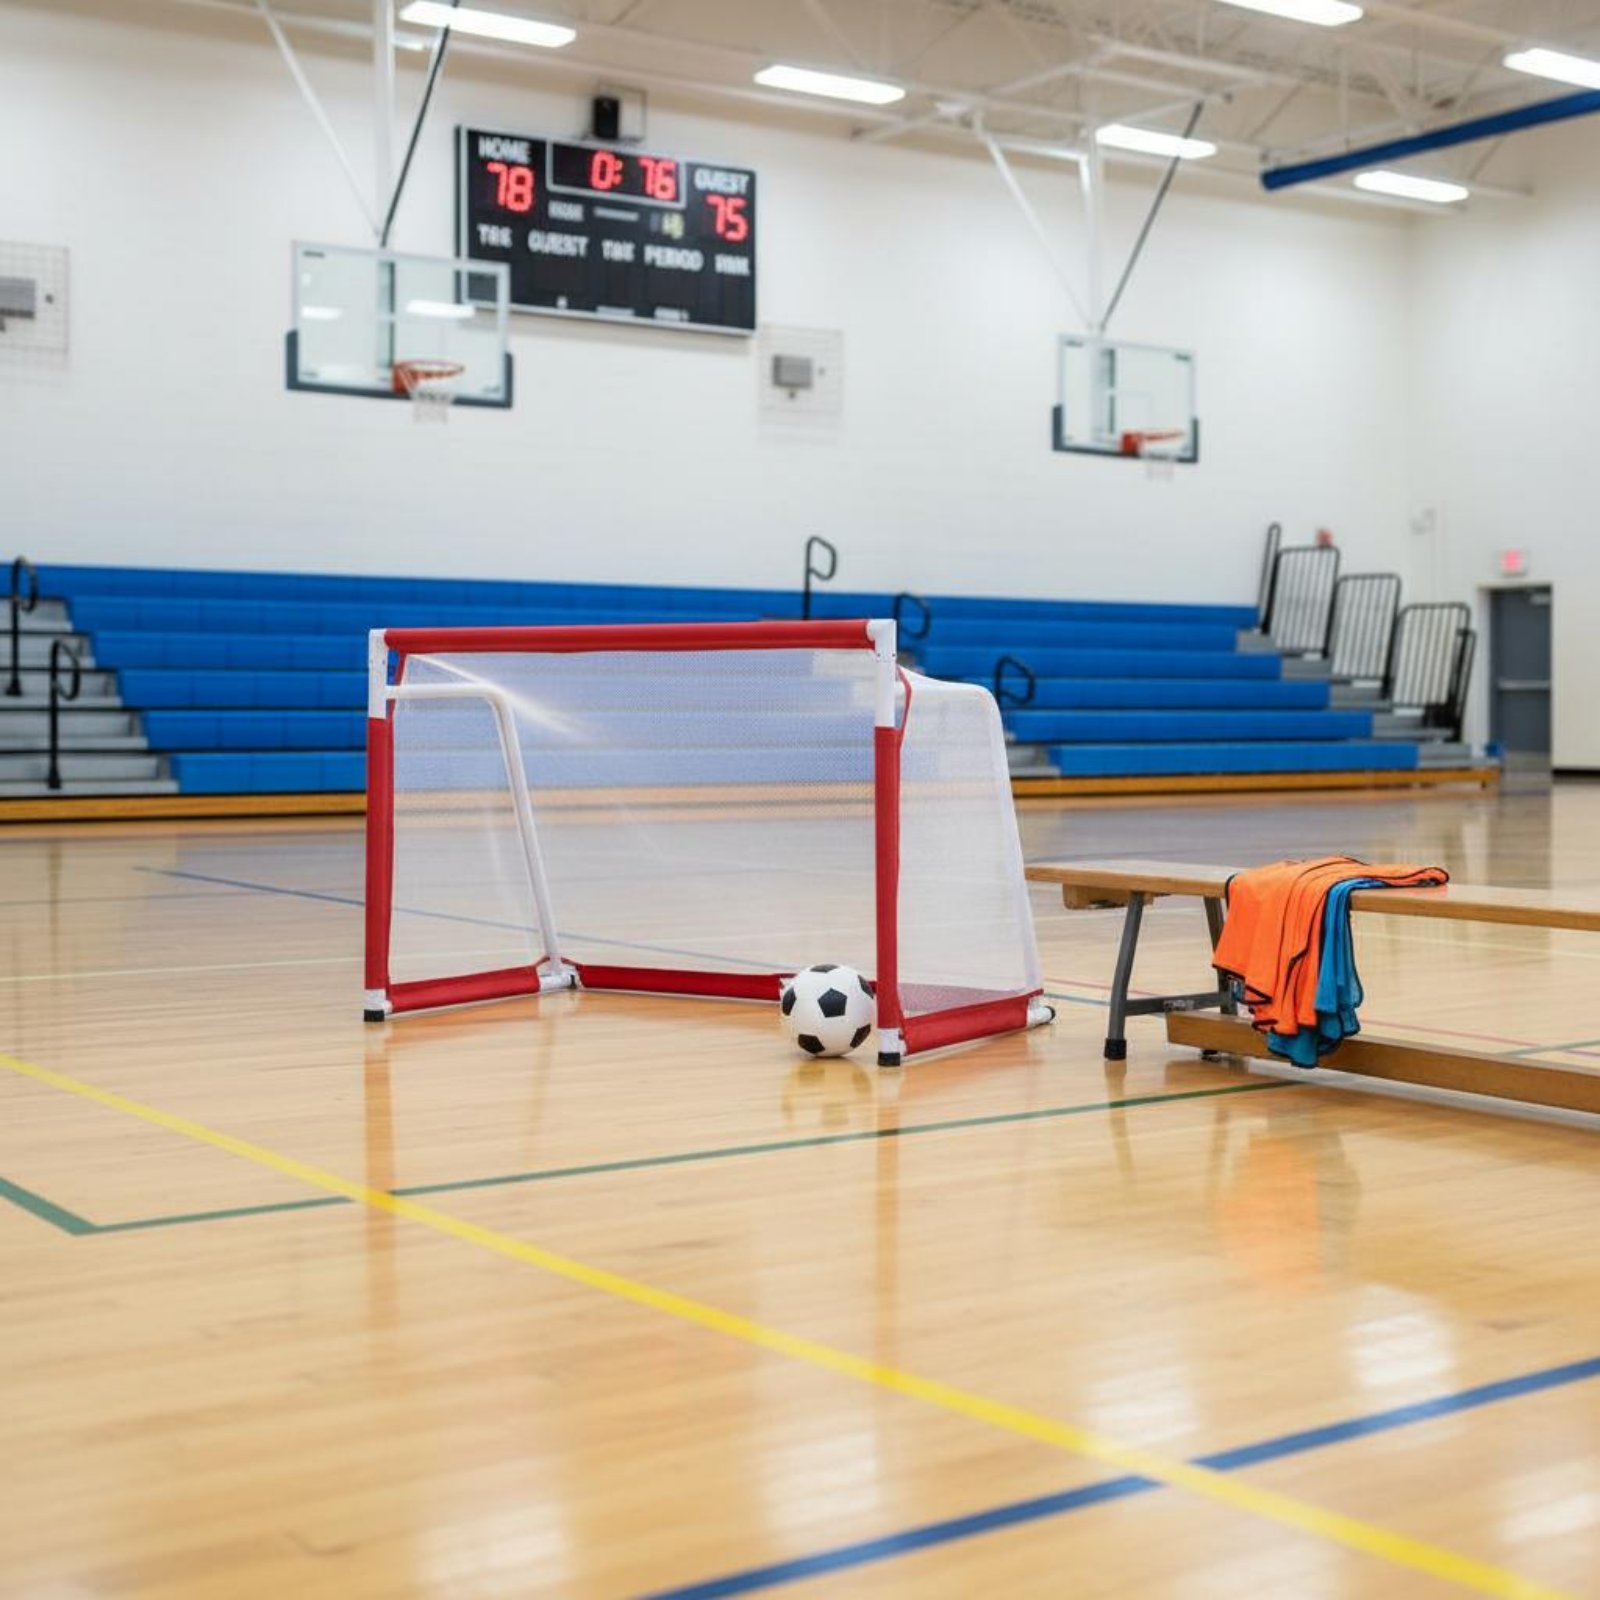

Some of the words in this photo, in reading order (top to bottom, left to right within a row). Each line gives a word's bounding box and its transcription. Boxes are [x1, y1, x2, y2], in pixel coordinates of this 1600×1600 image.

[478, 137, 531, 164] HOME
[486, 161, 535, 213] 78
[638, 156, 677, 201] 76
[706, 194, 749, 242] 75
